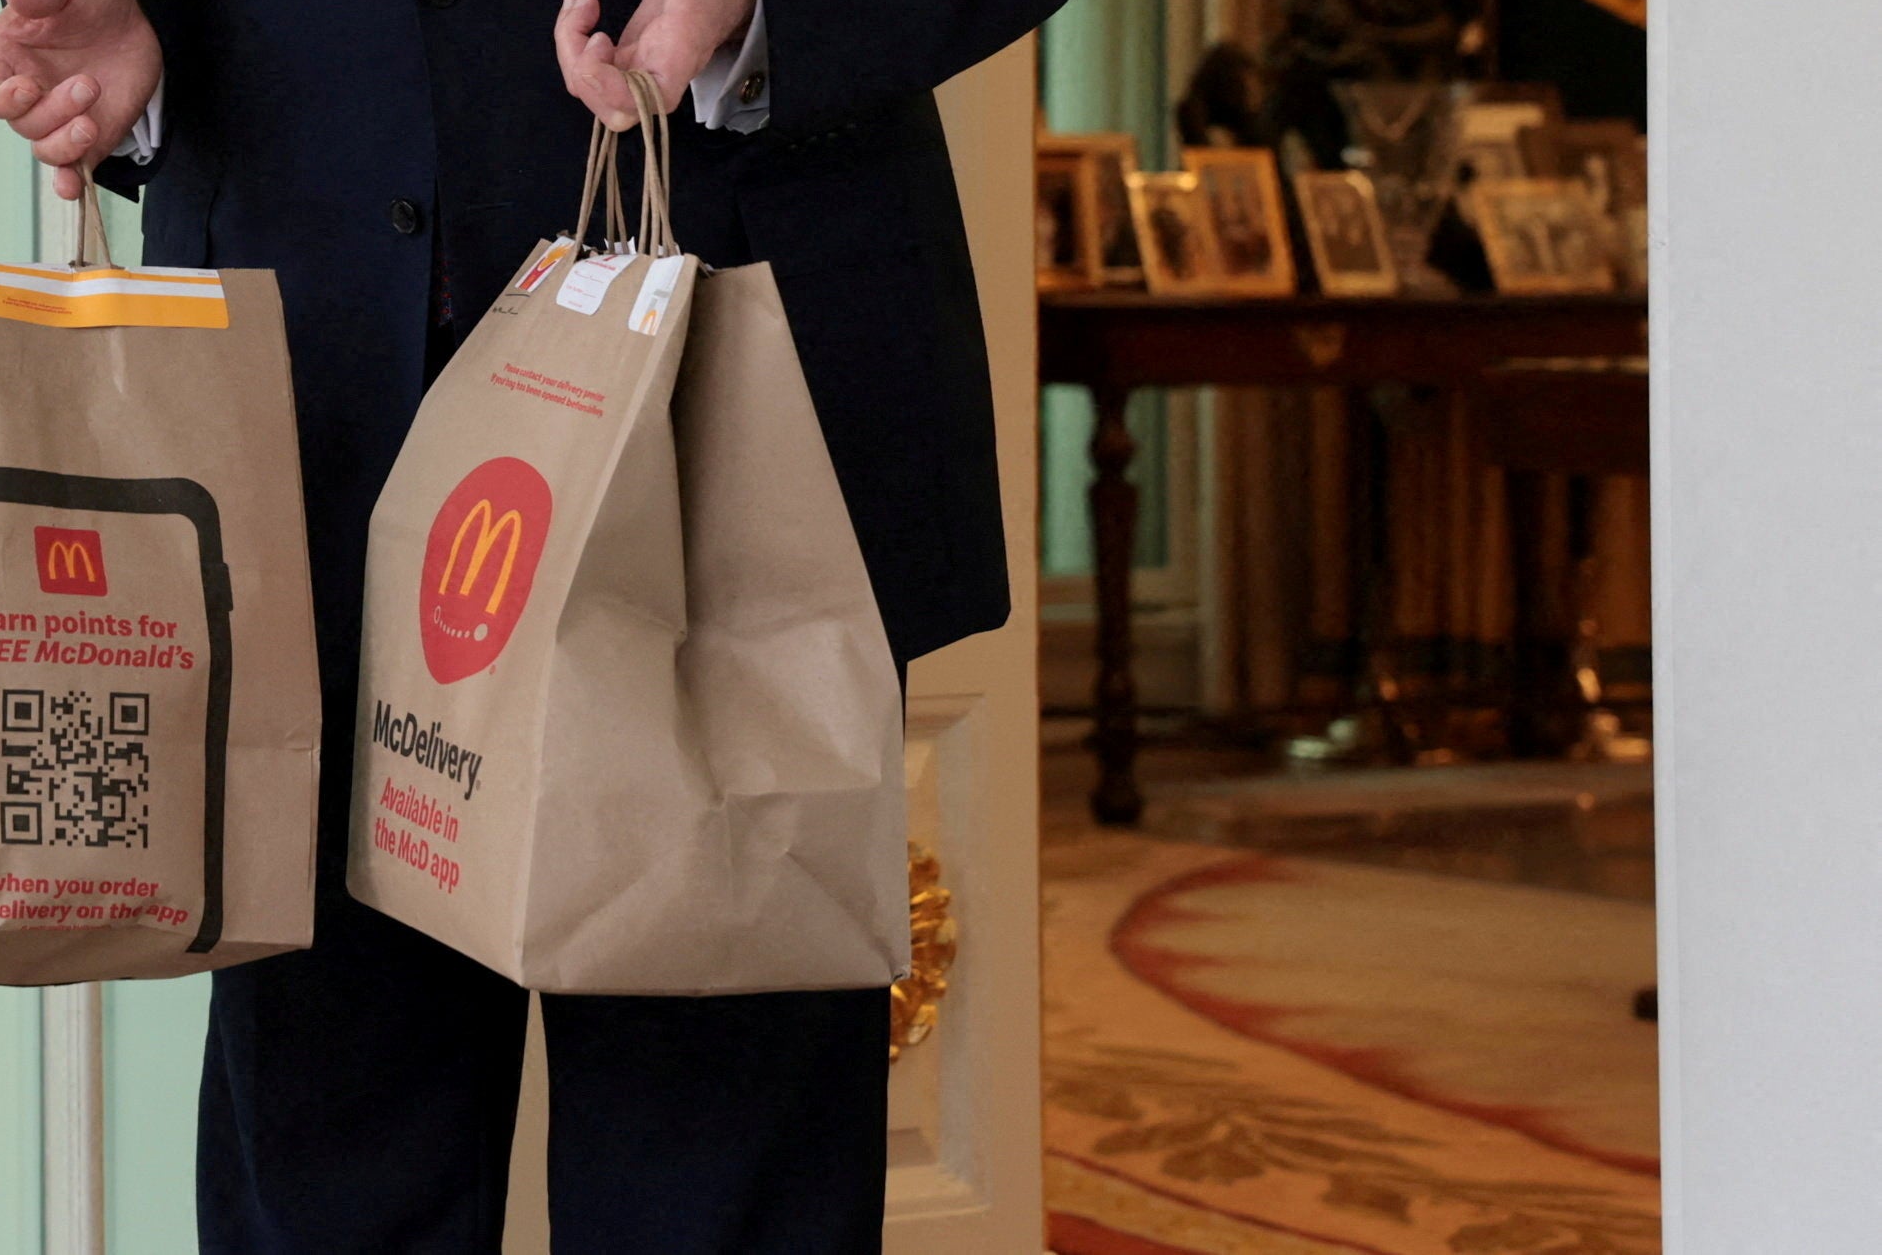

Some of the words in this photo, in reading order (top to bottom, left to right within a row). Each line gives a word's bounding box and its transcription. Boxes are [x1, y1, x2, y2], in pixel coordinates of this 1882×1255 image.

[44, 610, 133, 639] points
[138, 615, 178, 639] for
[34, 640, 194, 671] McDonald's
[373, 699, 483, 801] McDelivery
[380, 776, 443, 835] Available
[443, 804, 459, 843] in
[374, 817, 396, 856] the
[397, 829, 429, 872] McD
[430, 852, 460, 895] app
[54, 878, 97, 899] you
[99, 877, 160, 898] order
[75, 903, 104, 920] on
[145, 902, 189, 927] app
